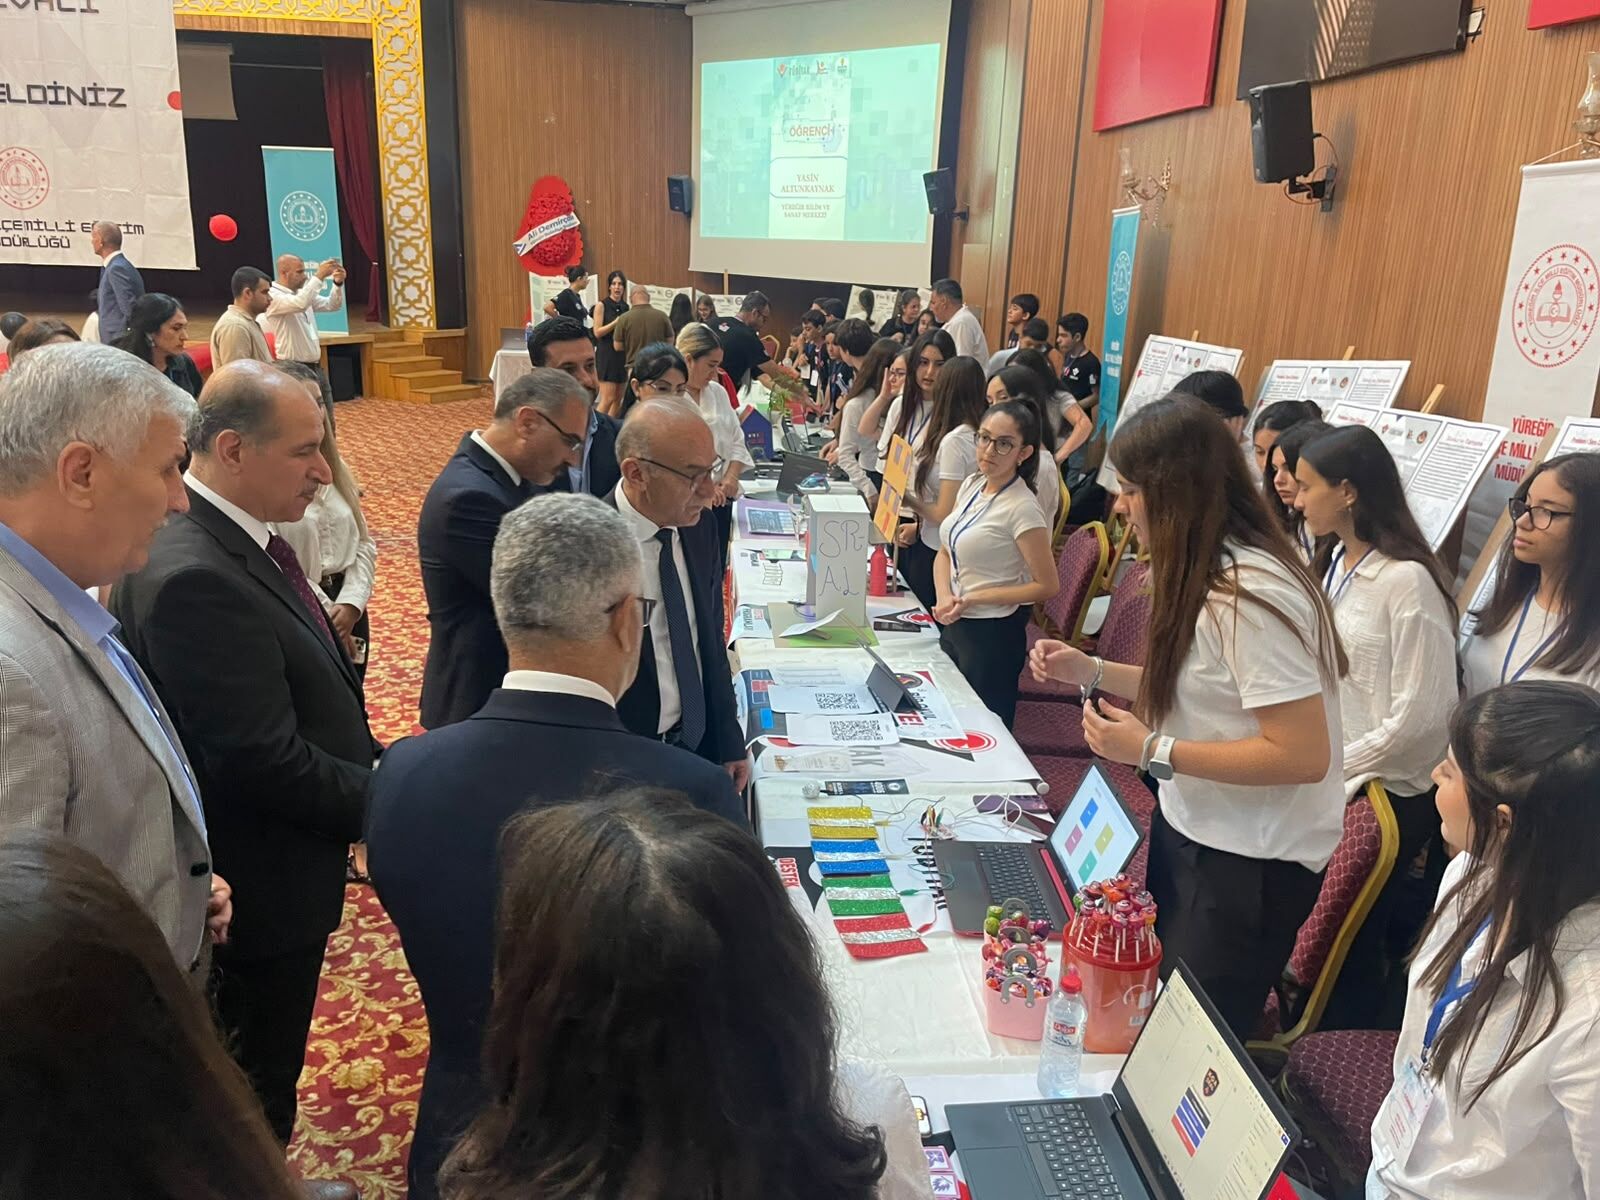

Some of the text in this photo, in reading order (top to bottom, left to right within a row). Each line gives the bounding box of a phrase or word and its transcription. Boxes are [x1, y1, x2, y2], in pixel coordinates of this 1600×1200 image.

[789, 123, 831, 137] ÖĞRENCİ
[797, 173, 819, 182] YASİN
[781, 185, 835, 193] ALTUNKAYNAK
[0, 234, 71, 249] DÜRLÜĞÜ
[778, 857, 800, 888] DESTEK
